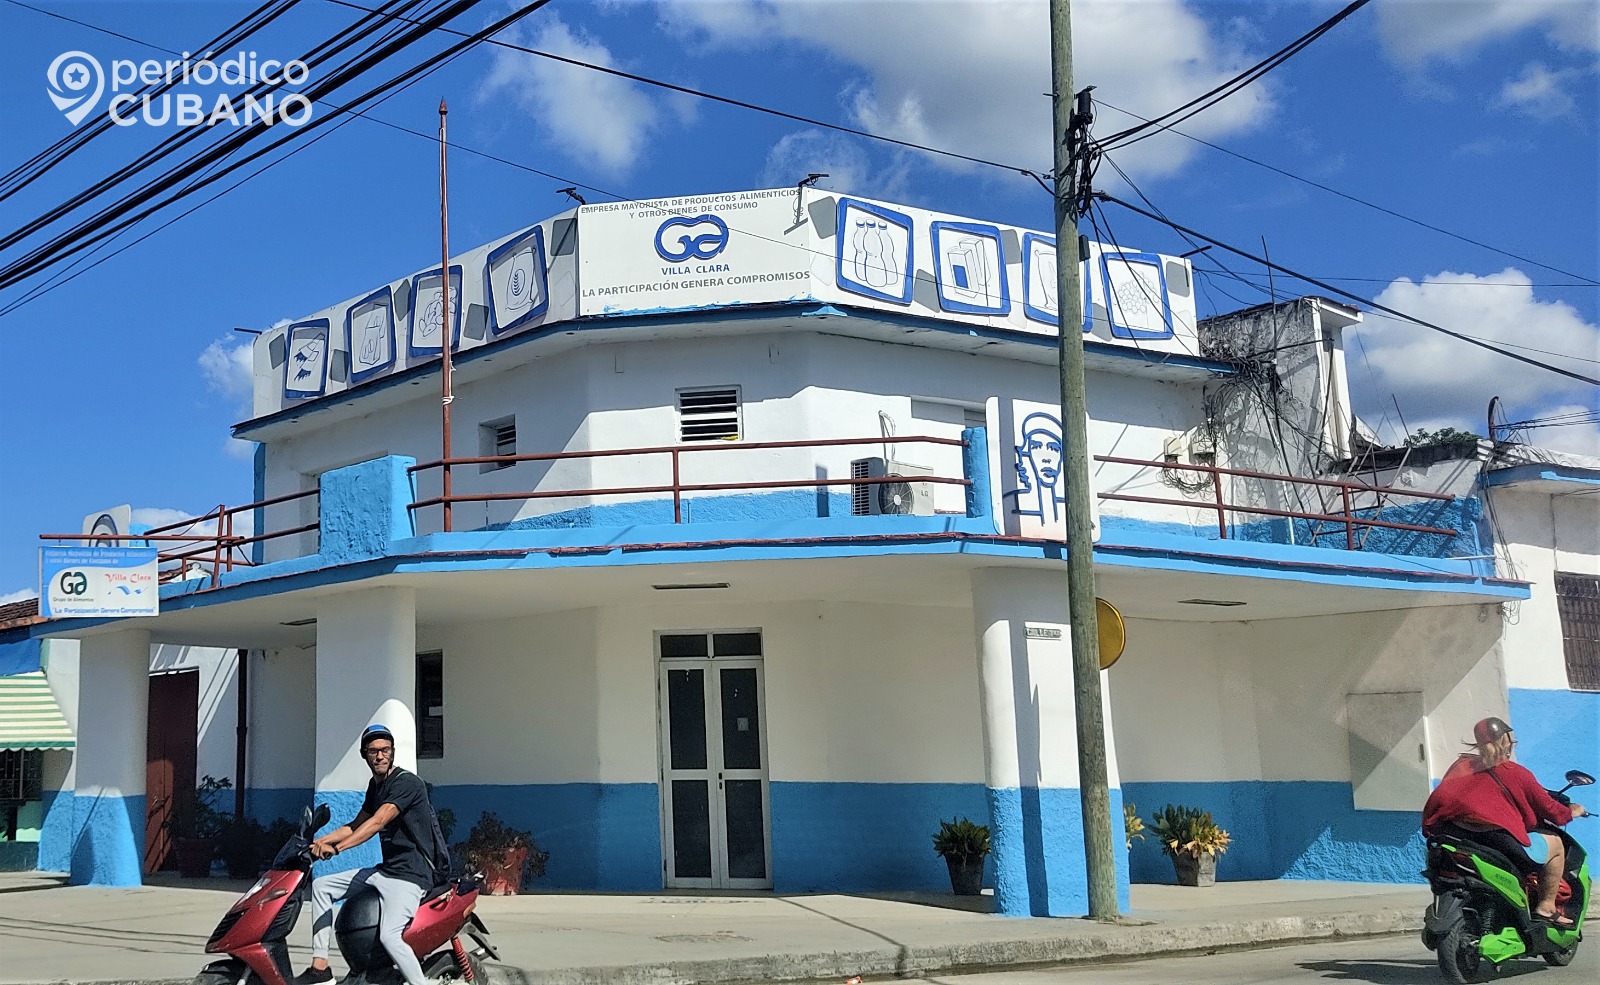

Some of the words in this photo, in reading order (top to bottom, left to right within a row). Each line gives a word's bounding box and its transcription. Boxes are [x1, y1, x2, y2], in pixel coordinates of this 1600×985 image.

[581, 204, 620, 214] EMPRESA
[621, 200, 669, 211] MAYORISTA
[684, 195, 737, 205] PRODUCTOS
[740, 189, 801, 200] ALIMENTICIOS
[638, 210, 667, 218] OTROS
[668, 206, 698, 215] BIENES
[701, 204, 712, 213] DE
[714, 202, 758, 211] CONSUMO
[661, 265, 691, 276] VILLA
[695, 264, 730, 274] CLARA
[582, 288, 596, 298] LA
[598, 280, 679, 296] PARTICIPACIÓN
[681, 278, 724, 289] GENERA
[727, 271, 810, 286] COMPROMISOS
[105, 573, 127, 582] Villa
[129, 573, 151, 583] Clara
